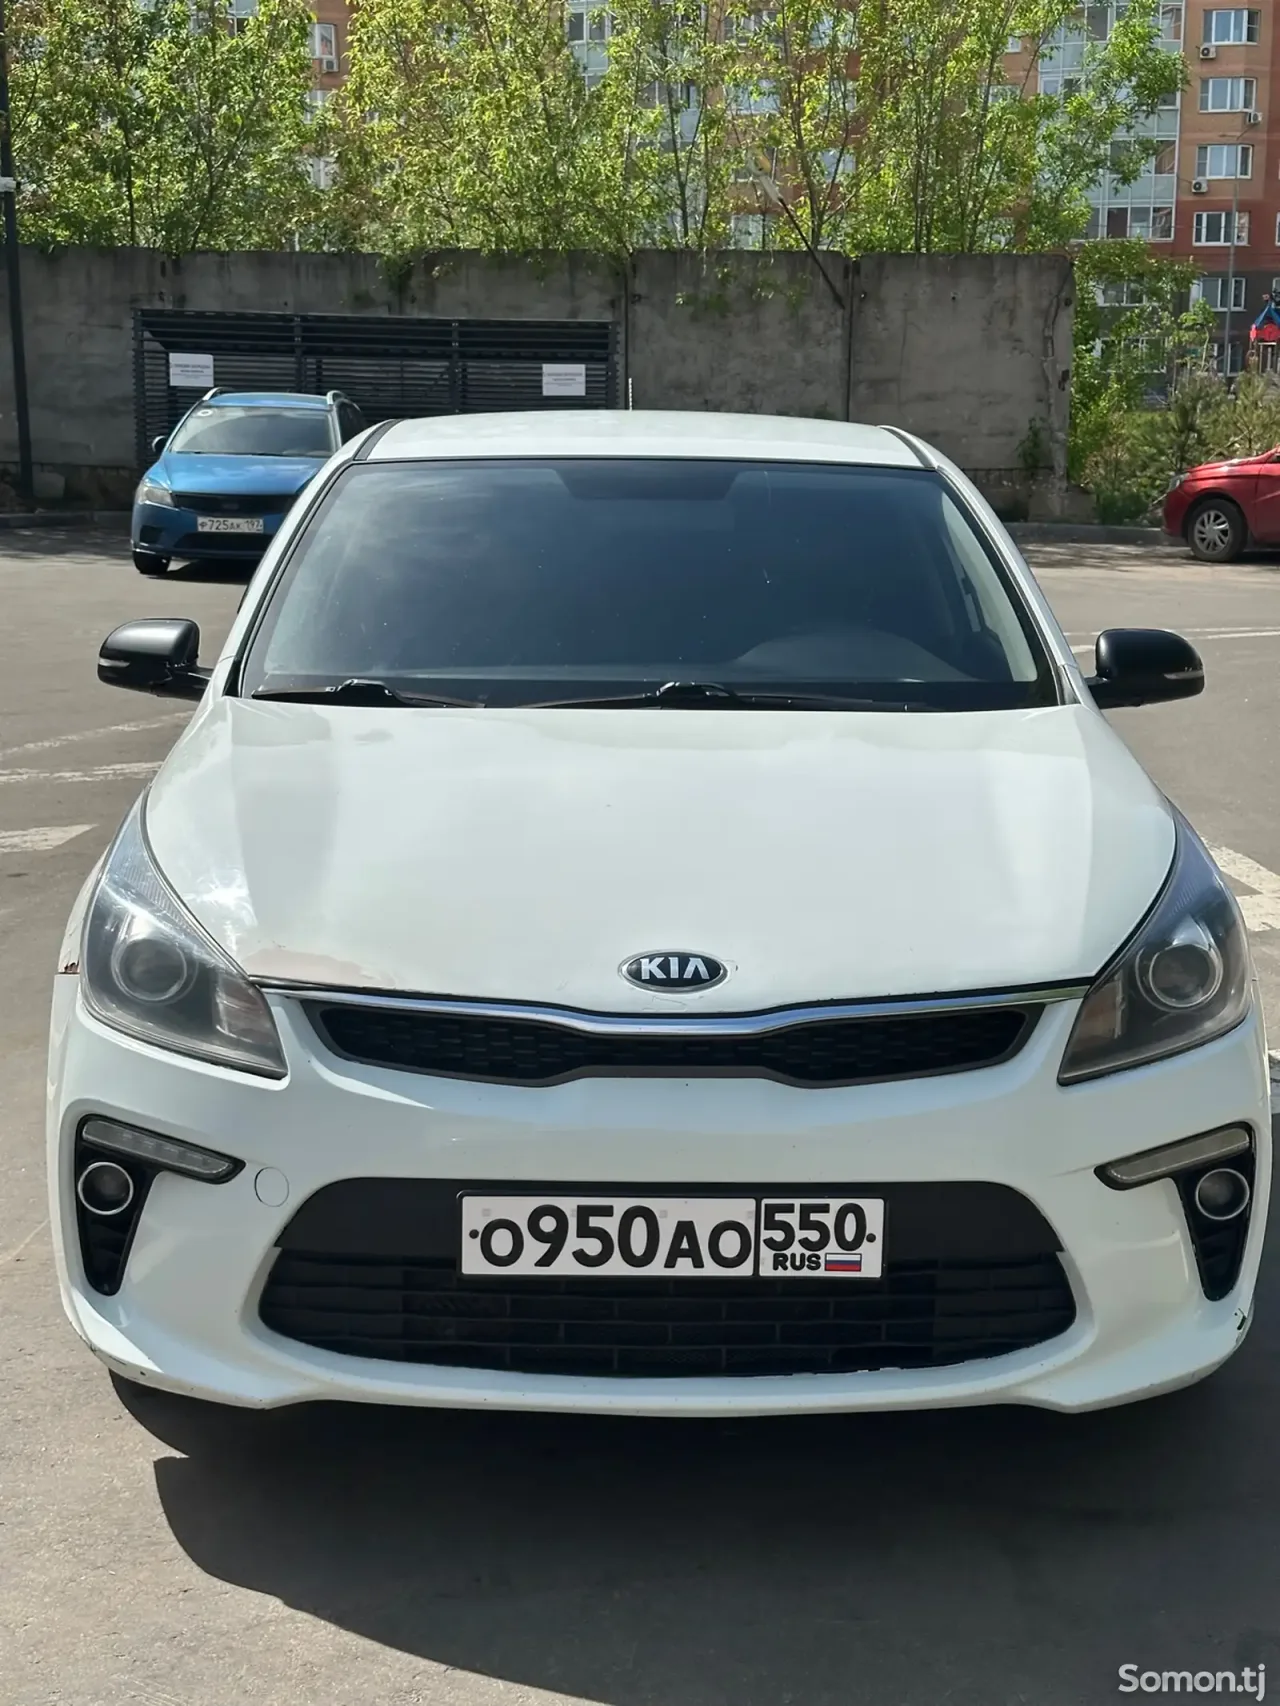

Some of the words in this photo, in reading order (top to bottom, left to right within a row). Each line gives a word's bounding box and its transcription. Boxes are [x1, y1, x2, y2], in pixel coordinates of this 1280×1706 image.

[640, 957, 710, 980] KIA
[763, 1203, 867, 1252] 550
[773, 1253, 821, 1271] RUS
